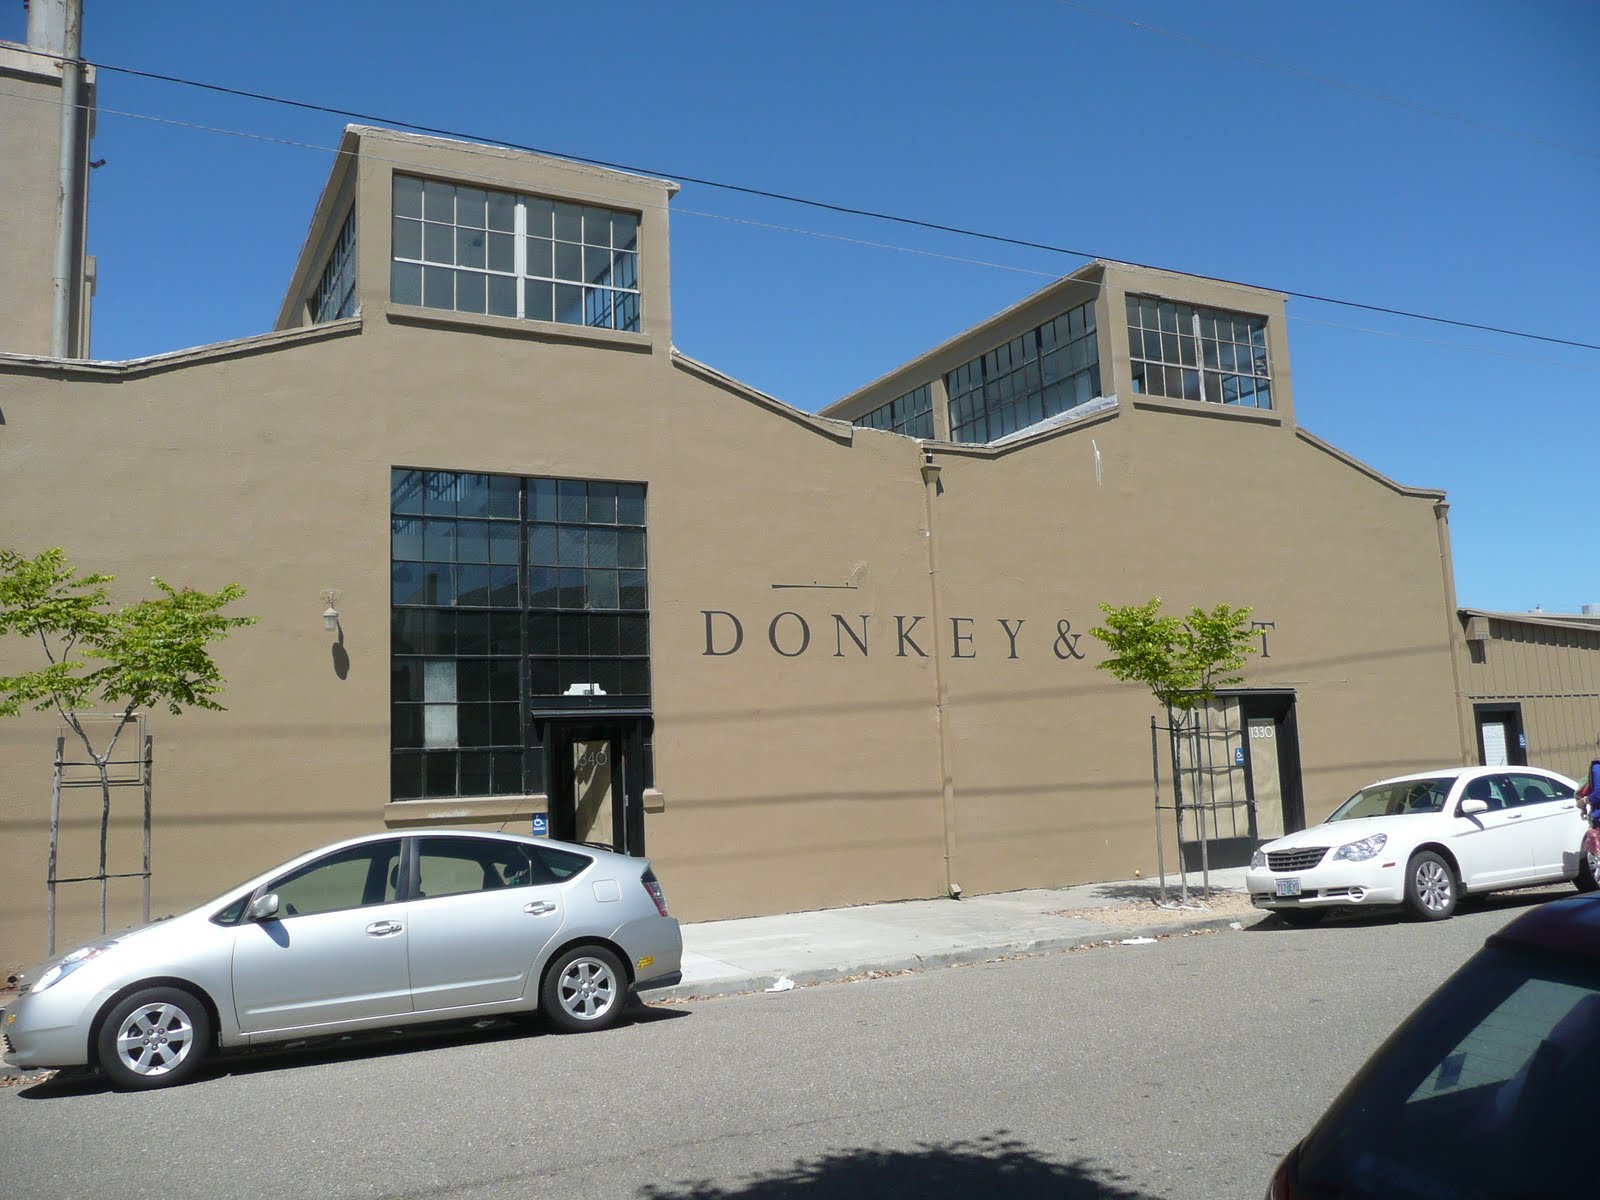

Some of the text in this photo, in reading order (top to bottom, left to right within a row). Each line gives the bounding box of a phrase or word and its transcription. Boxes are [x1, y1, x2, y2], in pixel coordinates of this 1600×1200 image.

[700, 610, 1026, 660] DONKEY
[1053, 619, 1085, 660] &
[1250, 725, 1273, 738] 1330
